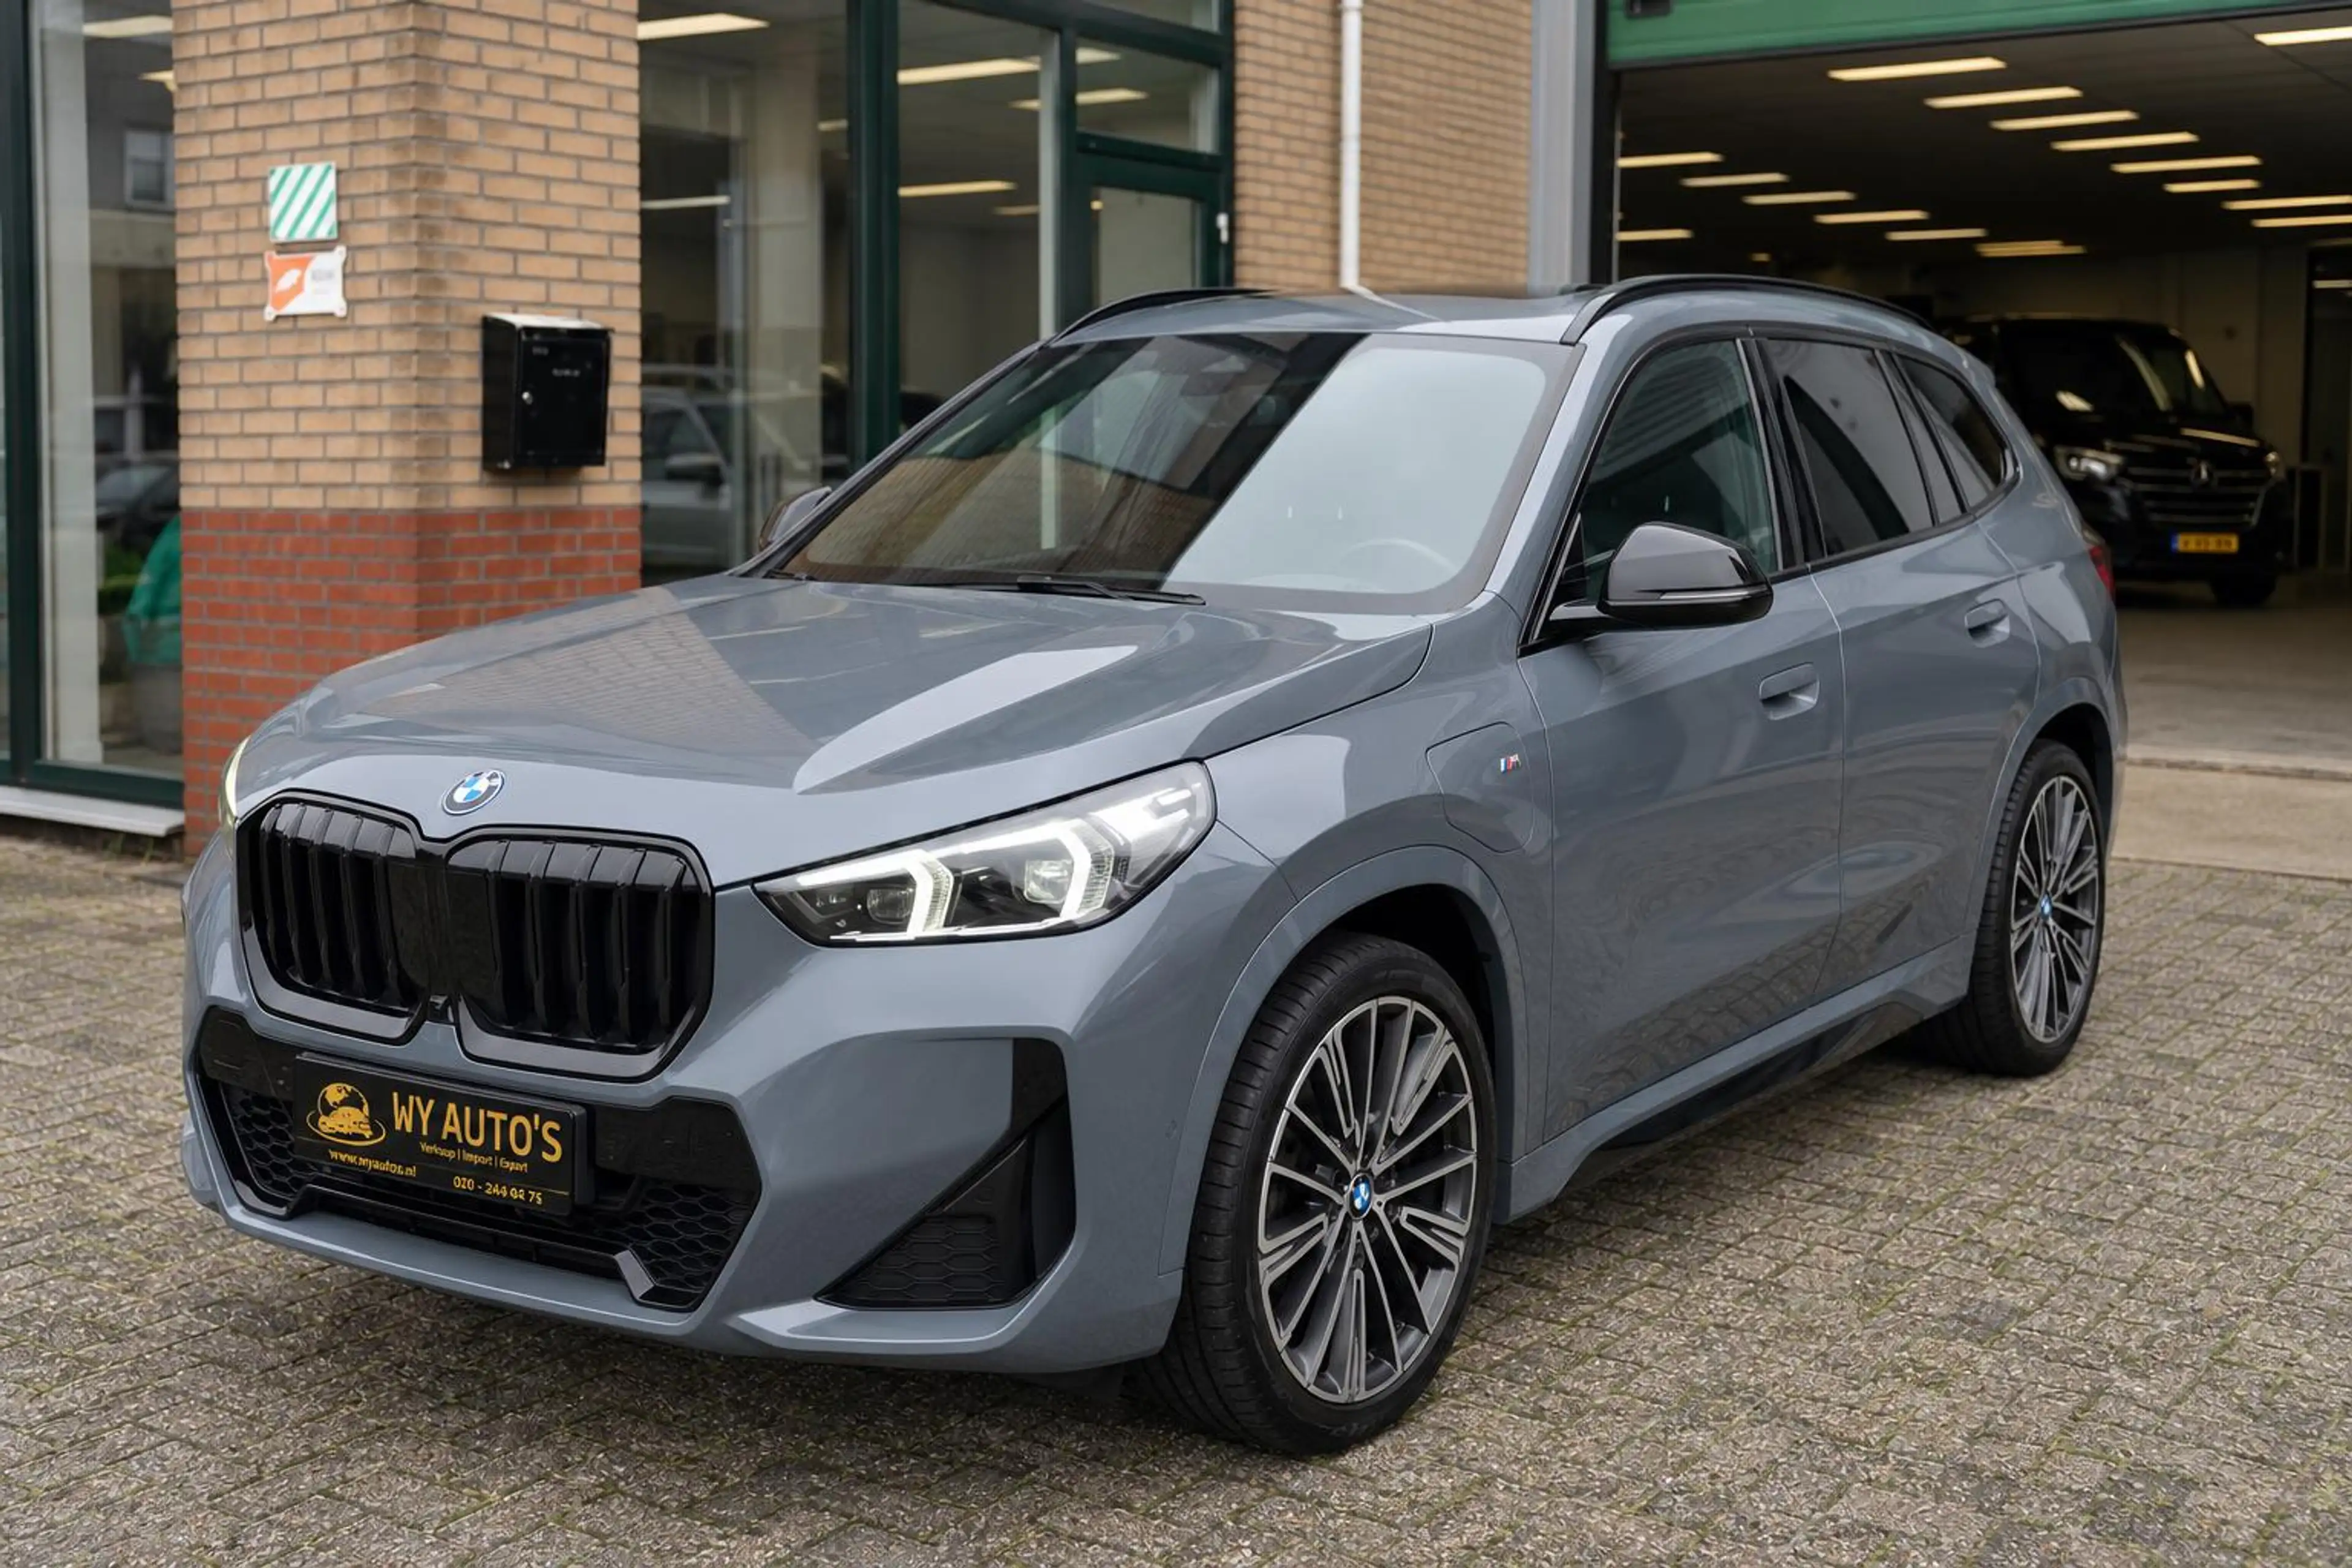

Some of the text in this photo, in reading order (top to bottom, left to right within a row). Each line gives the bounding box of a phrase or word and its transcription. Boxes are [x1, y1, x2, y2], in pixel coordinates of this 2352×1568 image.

[391, 1091, 563, 1163] WY AUTO'S
[419, 1141, 456, 1163] Verkoop
[462, 1149, 493, 1166] Import
[499, 1156, 528, 1173] Export
[453, 1175, 475, 1191] 020
[528, 1190, 543, 1205] 75
